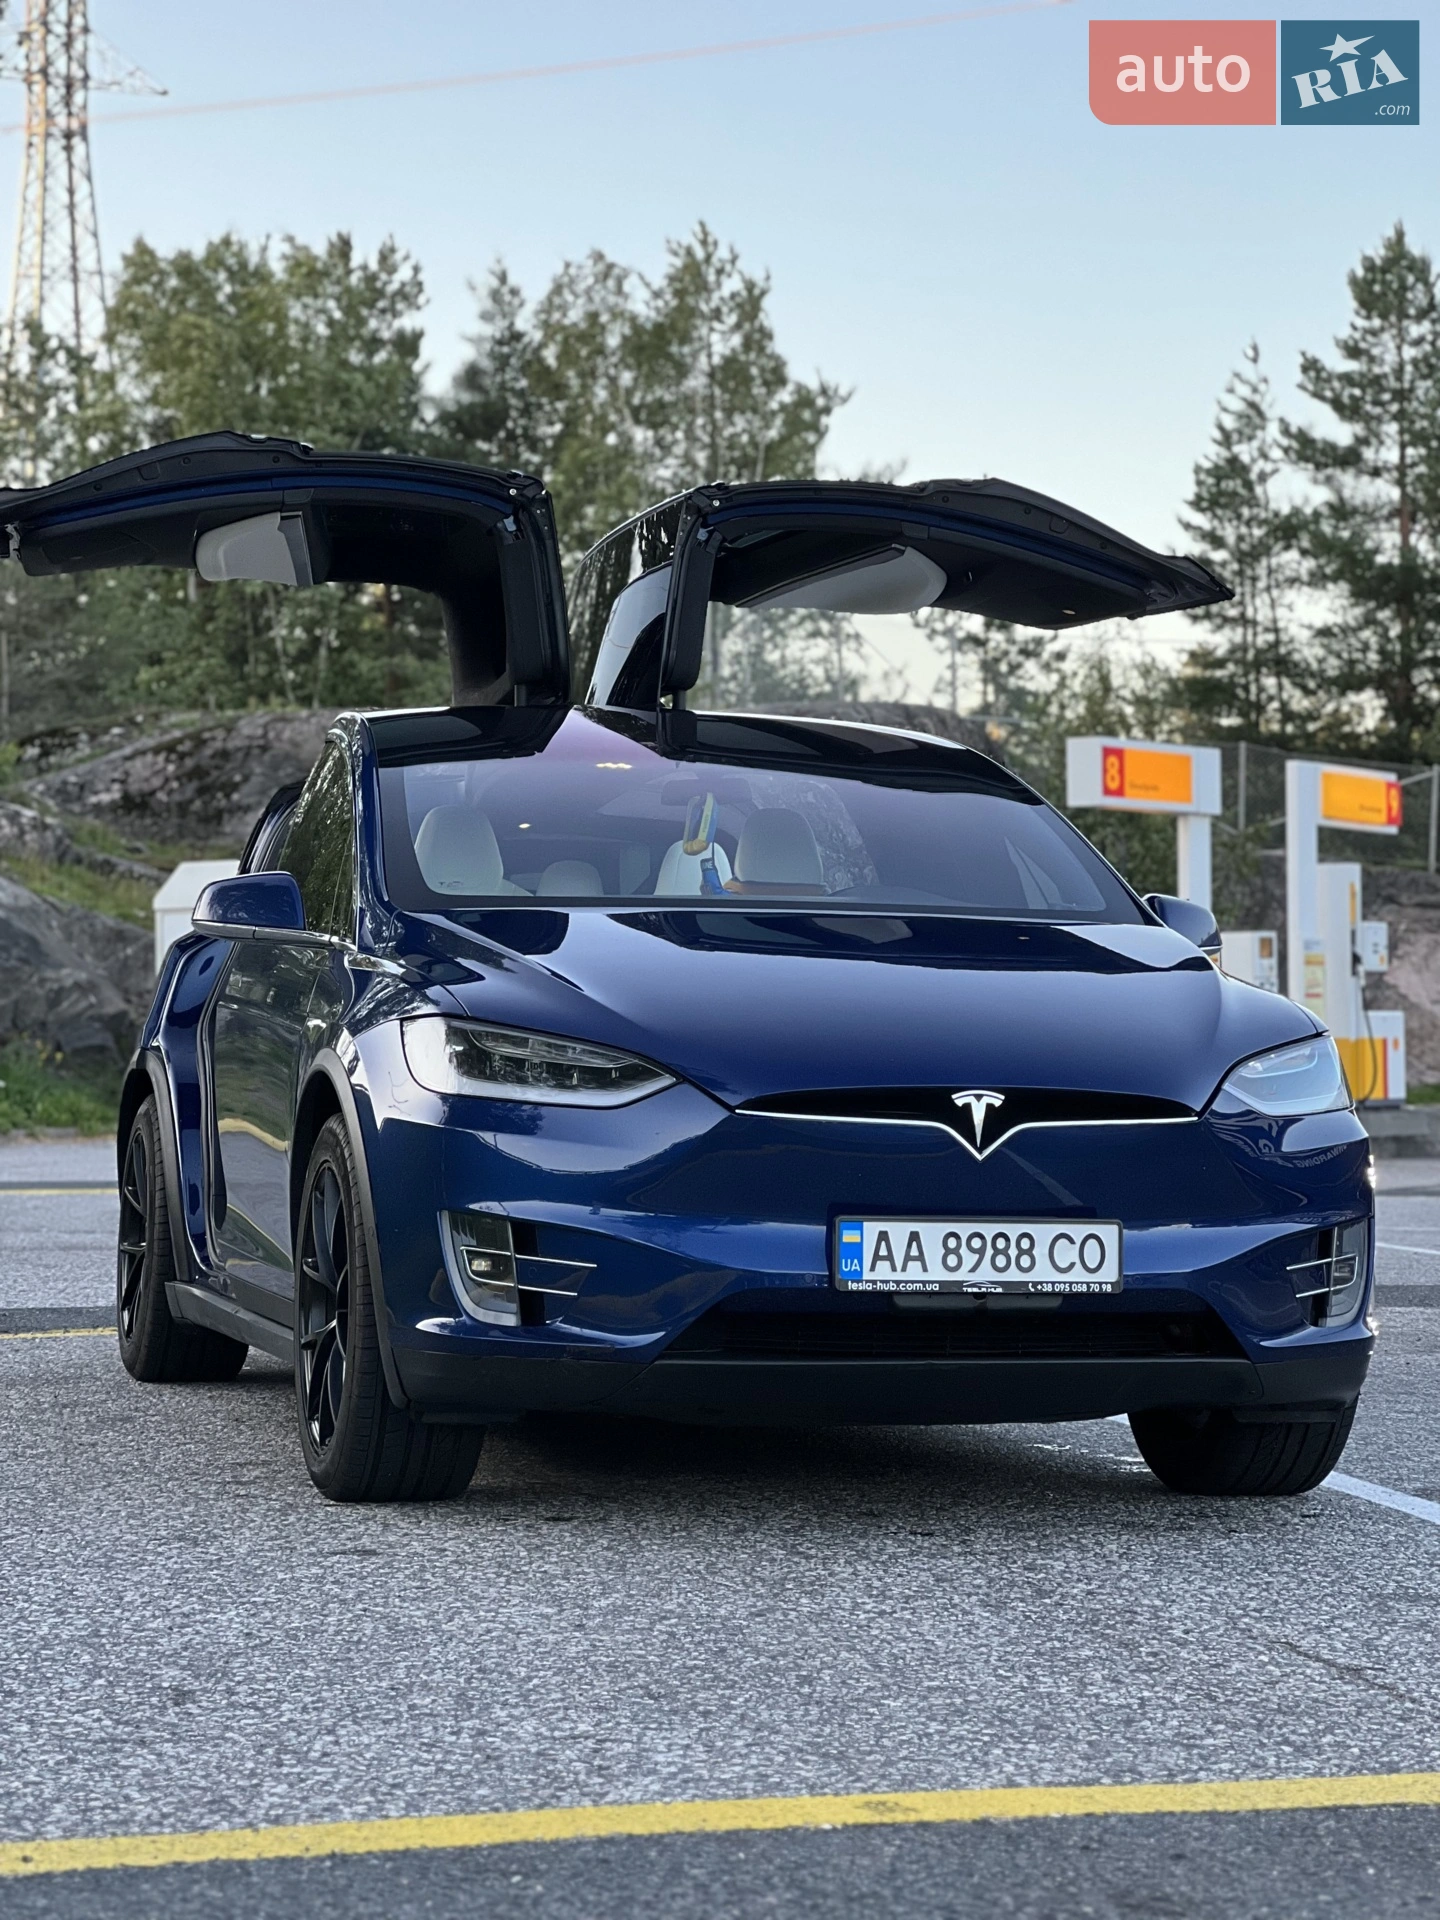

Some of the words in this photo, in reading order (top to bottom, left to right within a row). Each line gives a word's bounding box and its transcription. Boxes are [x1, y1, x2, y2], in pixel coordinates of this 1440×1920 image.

[1105, 754, 1120, 791] 8
[1389, 786, 1400, 818] 9
[869, 1230, 929, 1273] AA
[941, 1231, 1036, 1274] 8988
[1049, 1232, 1106, 1274] CO
[842, 1258, 861, 1272] UA
[848, 1280, 940, 1291] tesla-hub.com.ua
[1037, 1283, 1052, 1292] +38
[1054, 1283, 1070, 1292] 095
[1072, 1283, 1087, 1292] 058
[1089, 1283, 1100, 1292] 70
[1101, 1283, 1112, 1292] 98
